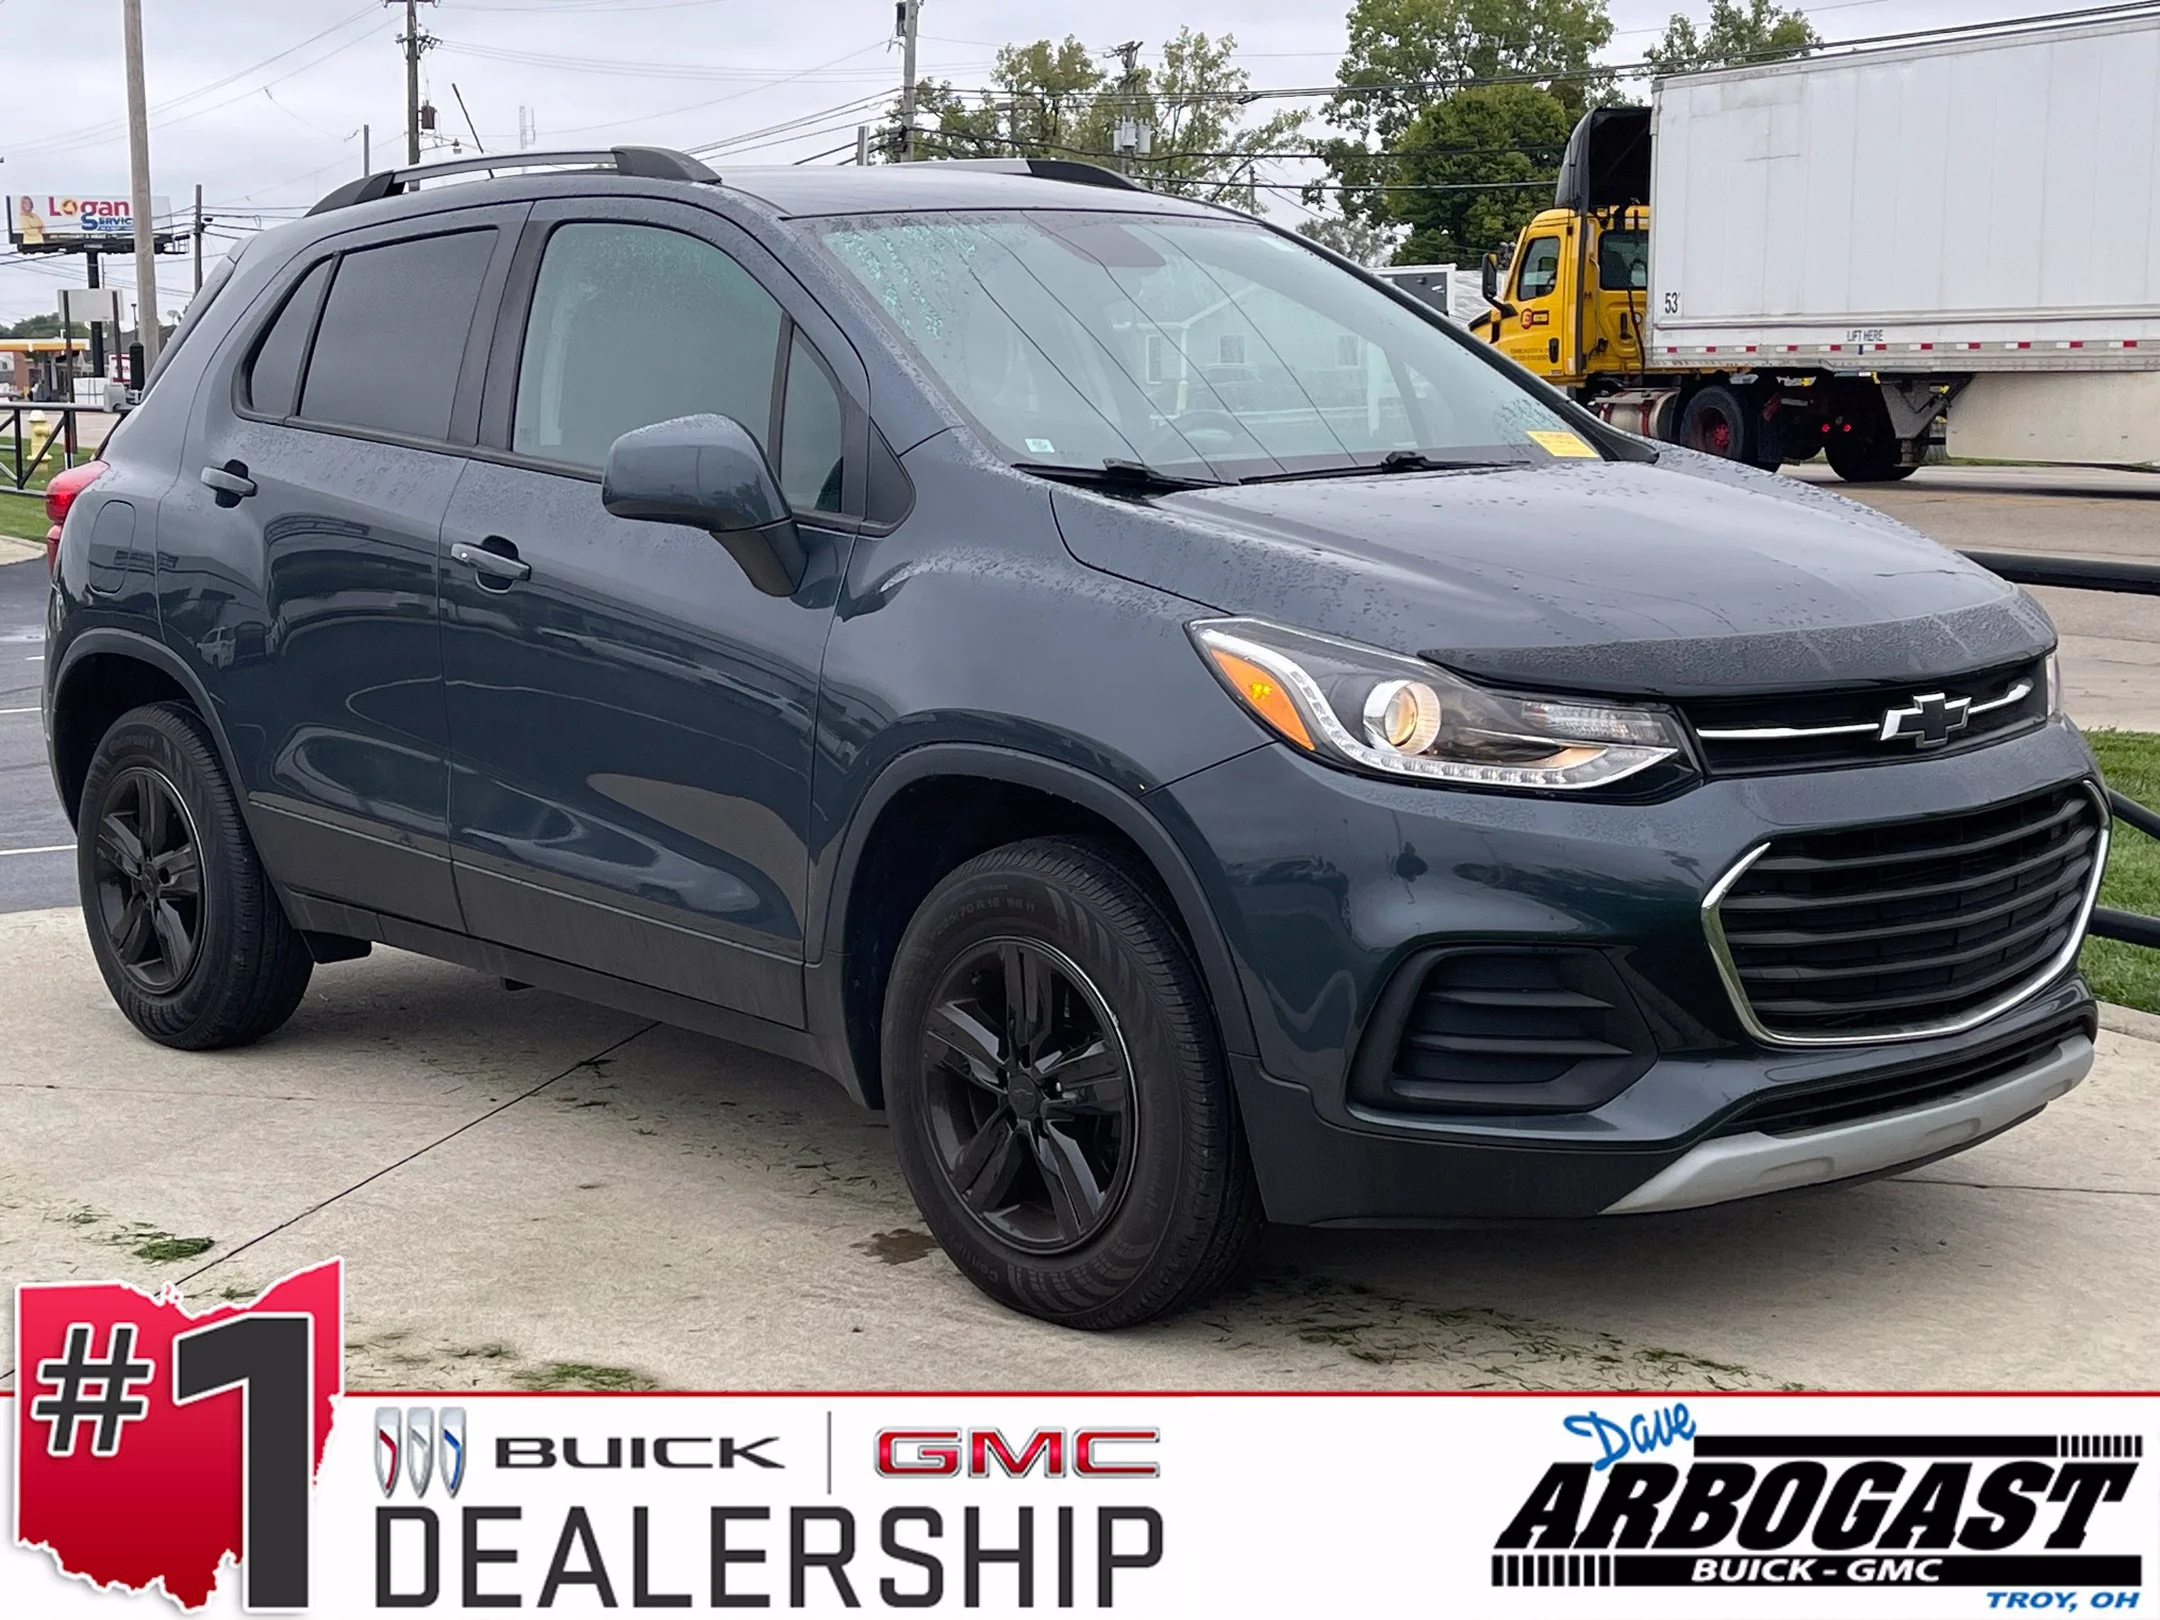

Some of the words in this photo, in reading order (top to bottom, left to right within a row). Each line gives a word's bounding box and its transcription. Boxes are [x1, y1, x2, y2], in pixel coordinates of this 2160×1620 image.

[49, 196, 129, 216] Logan
[81, 212, 134, 231] SERVIC
[1847, 330, 1862, 342] LIFT
[1863, 330, 1884, 342] HERE
